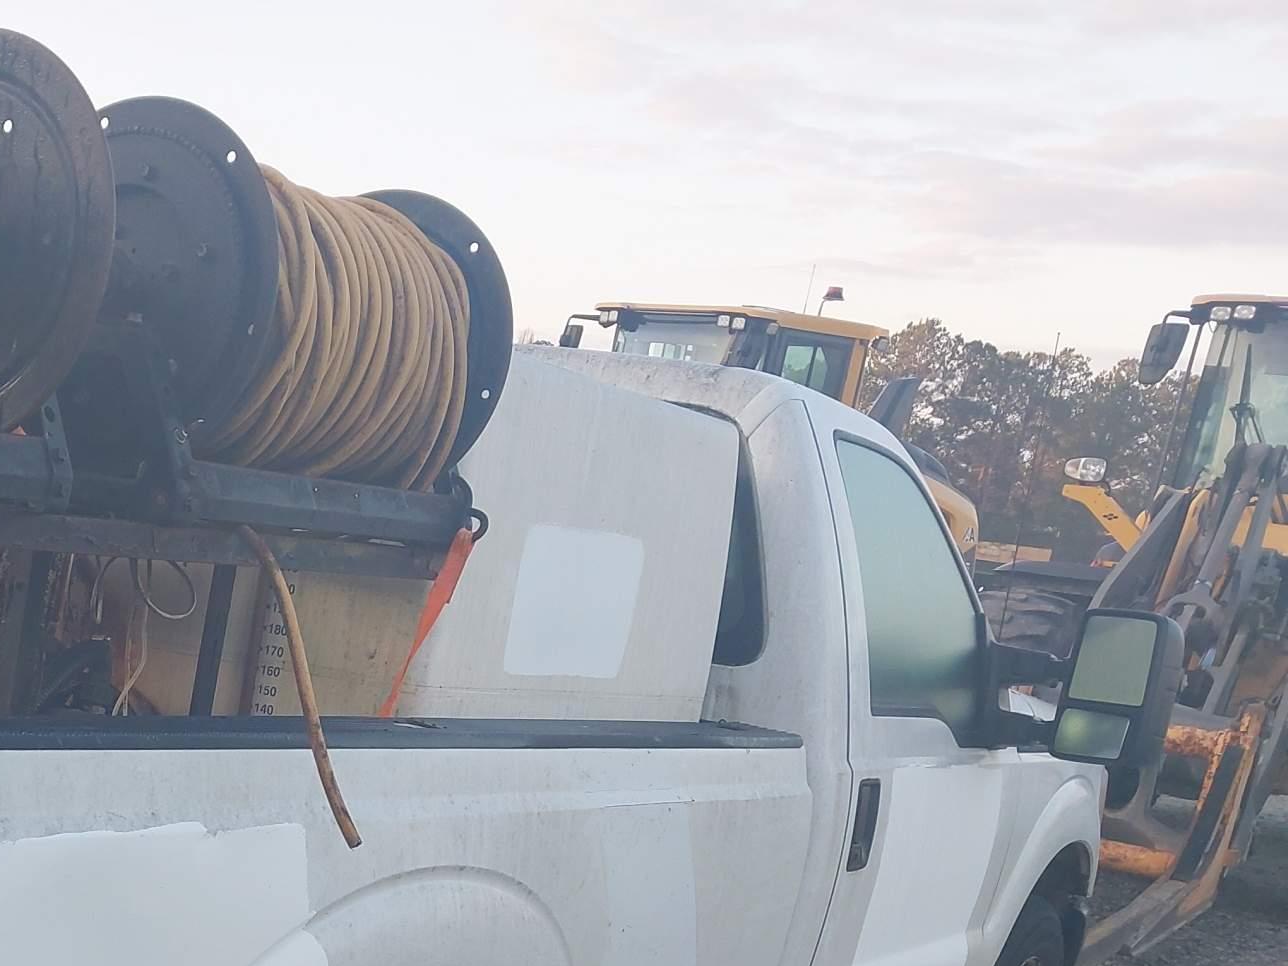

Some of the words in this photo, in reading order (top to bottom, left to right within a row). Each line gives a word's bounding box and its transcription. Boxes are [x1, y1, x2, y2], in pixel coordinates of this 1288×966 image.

[269, 624, 288, 636] 180
[265, 645, 284, 658] 170
[261, 665, 281, 678] 160
[258, 685, 277, 697] 150
[255, 703, 274, 716] 140
